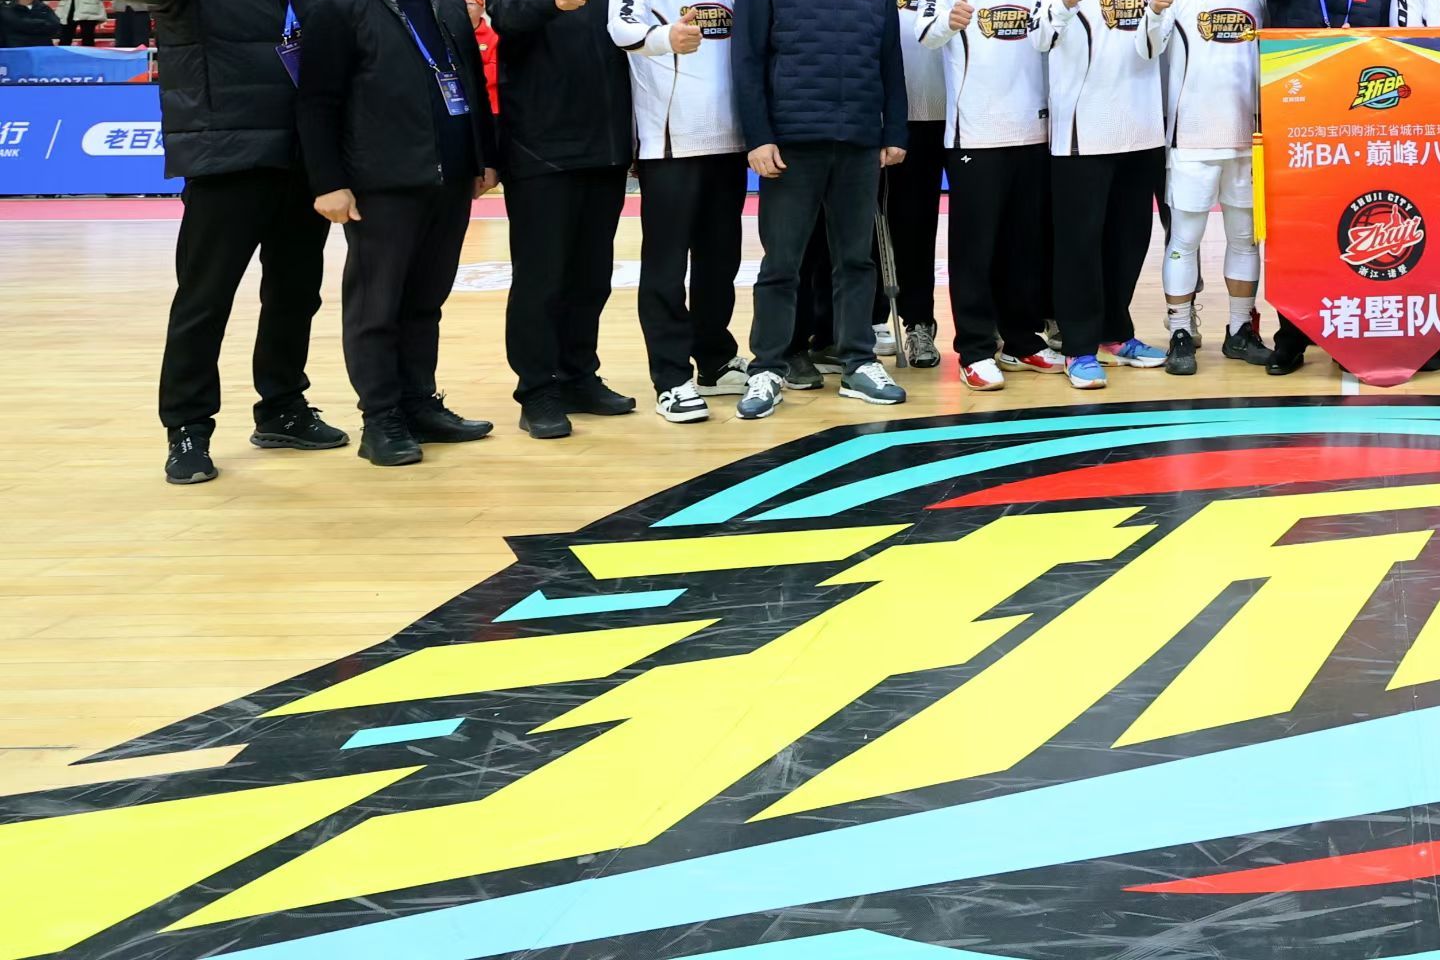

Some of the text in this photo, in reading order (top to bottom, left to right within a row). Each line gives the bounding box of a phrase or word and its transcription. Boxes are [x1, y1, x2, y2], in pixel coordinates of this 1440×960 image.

[703, 27, 728, 35] 2025
[1351, 191, 1414, 212] ZHUJI CITY
[1358, 264, 1408, 278] 浙江·诸暨
